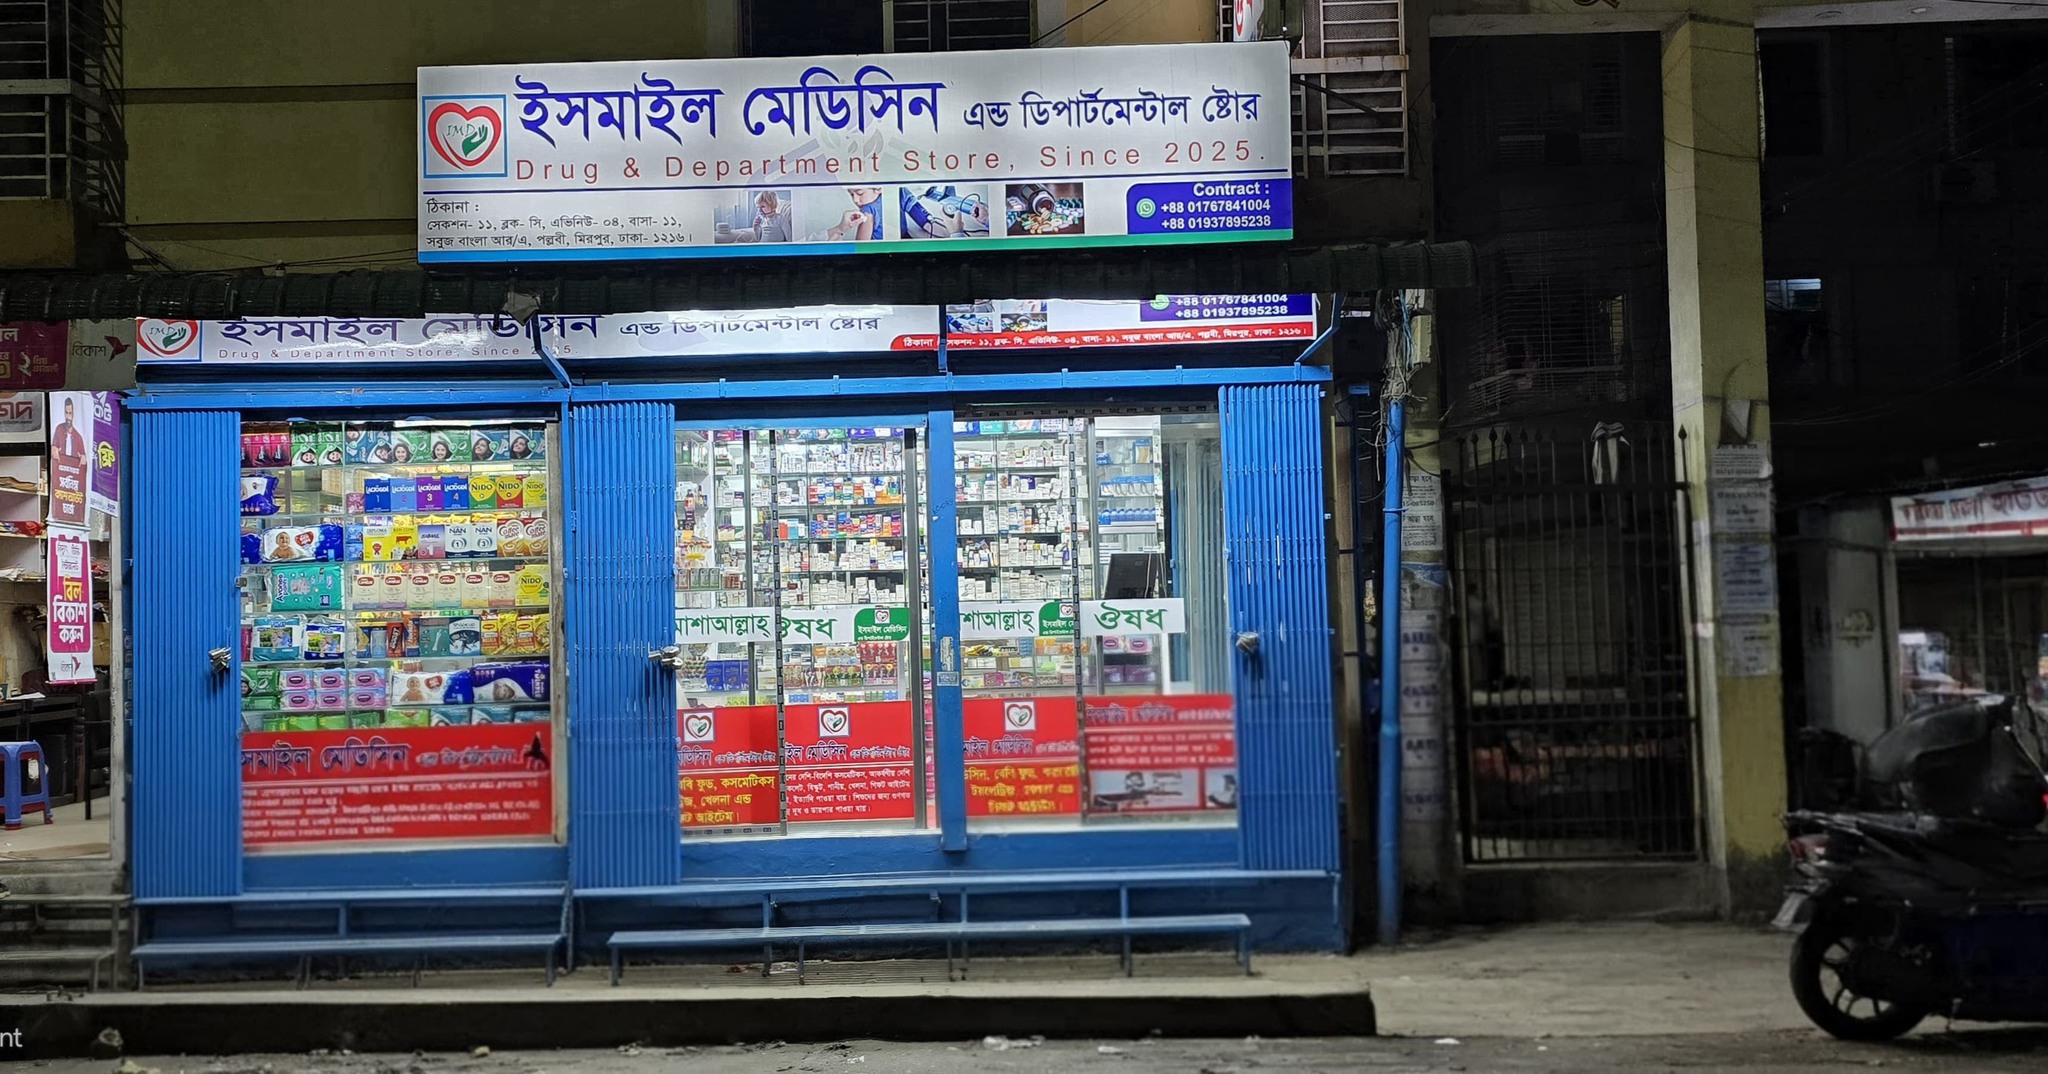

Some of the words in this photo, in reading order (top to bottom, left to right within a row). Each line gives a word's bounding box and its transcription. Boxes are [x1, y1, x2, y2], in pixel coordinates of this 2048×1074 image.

[514, 72, 724, 149] ইসমাইল
[743, 66, 946, 139] মেডিসিন
[964, 101, 1011, 130] এন্ড
[1020, 88, 1190, 128] ডিপার্টমেন্টাল
[517, 160, 598, 184] Drug
[624, 159, 640, 178] &
[666, 150, 879, 181] Department
[904, 147, 1015, 172] Store,
[1041, 147, 1140, 167] Since
[1165, 140, 1266, 163] 2025.
[1193, 182, 1260, 196] Contract
[427, 199, 469, 213] ঠিকানা
[1161, 202, 1184, 213] +88
[1188, 199, 1270, 212] 01767841004
[1162, 218, 1184, 229] +88
[1188, 216, 1271, 228] 01937895238
[426, 237, 454, 248] সবুজ
[458, 236, 487, 246] বাংলা
[1176, 309, 1199, 318] +88
[1203, 306, 1288, 317] 01937895238
[72, 341, 106, 356] বিকাশ
[219, 349, 260, 360] Drug
[291, 349, 396, 360] Department
[472, 346, 520, 356] Since
[63, 576, 82, 602] বিল
[53, 595, 87, 623] বিকাশ
[1095, 602, 1168, 632] ঔষধ
[59, 625, 84, 644] করুন
